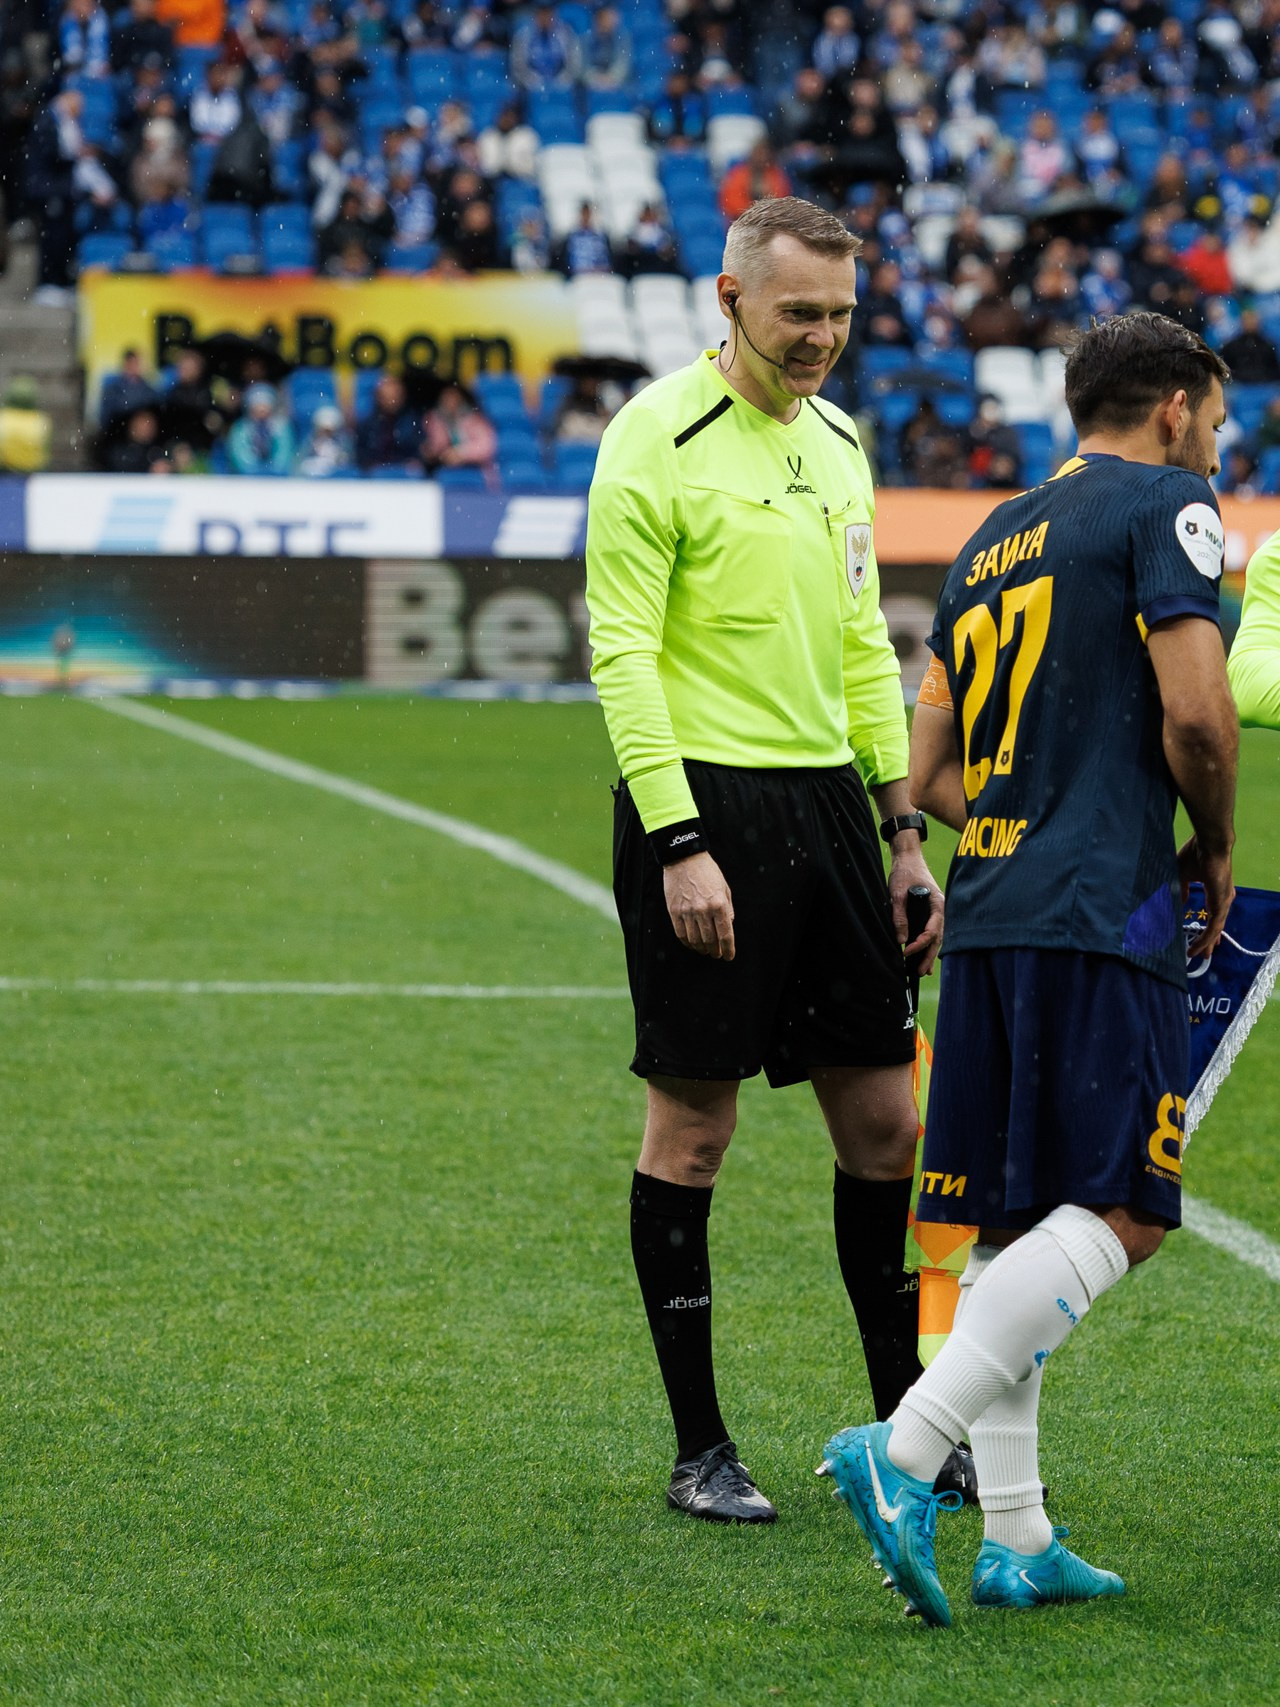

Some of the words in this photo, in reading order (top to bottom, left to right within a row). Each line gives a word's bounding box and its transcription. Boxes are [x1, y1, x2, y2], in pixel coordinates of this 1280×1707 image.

[155, 313, 515, 378] BBoom
[785, 483, 817, 495] JÖGEL
[365, 560, 590, 686] Be
[952, 575, 1054, 801] 27
[669, 831, 700, 847] JÖGEL
[662, 1295, 710, 1309] JÖGEL
